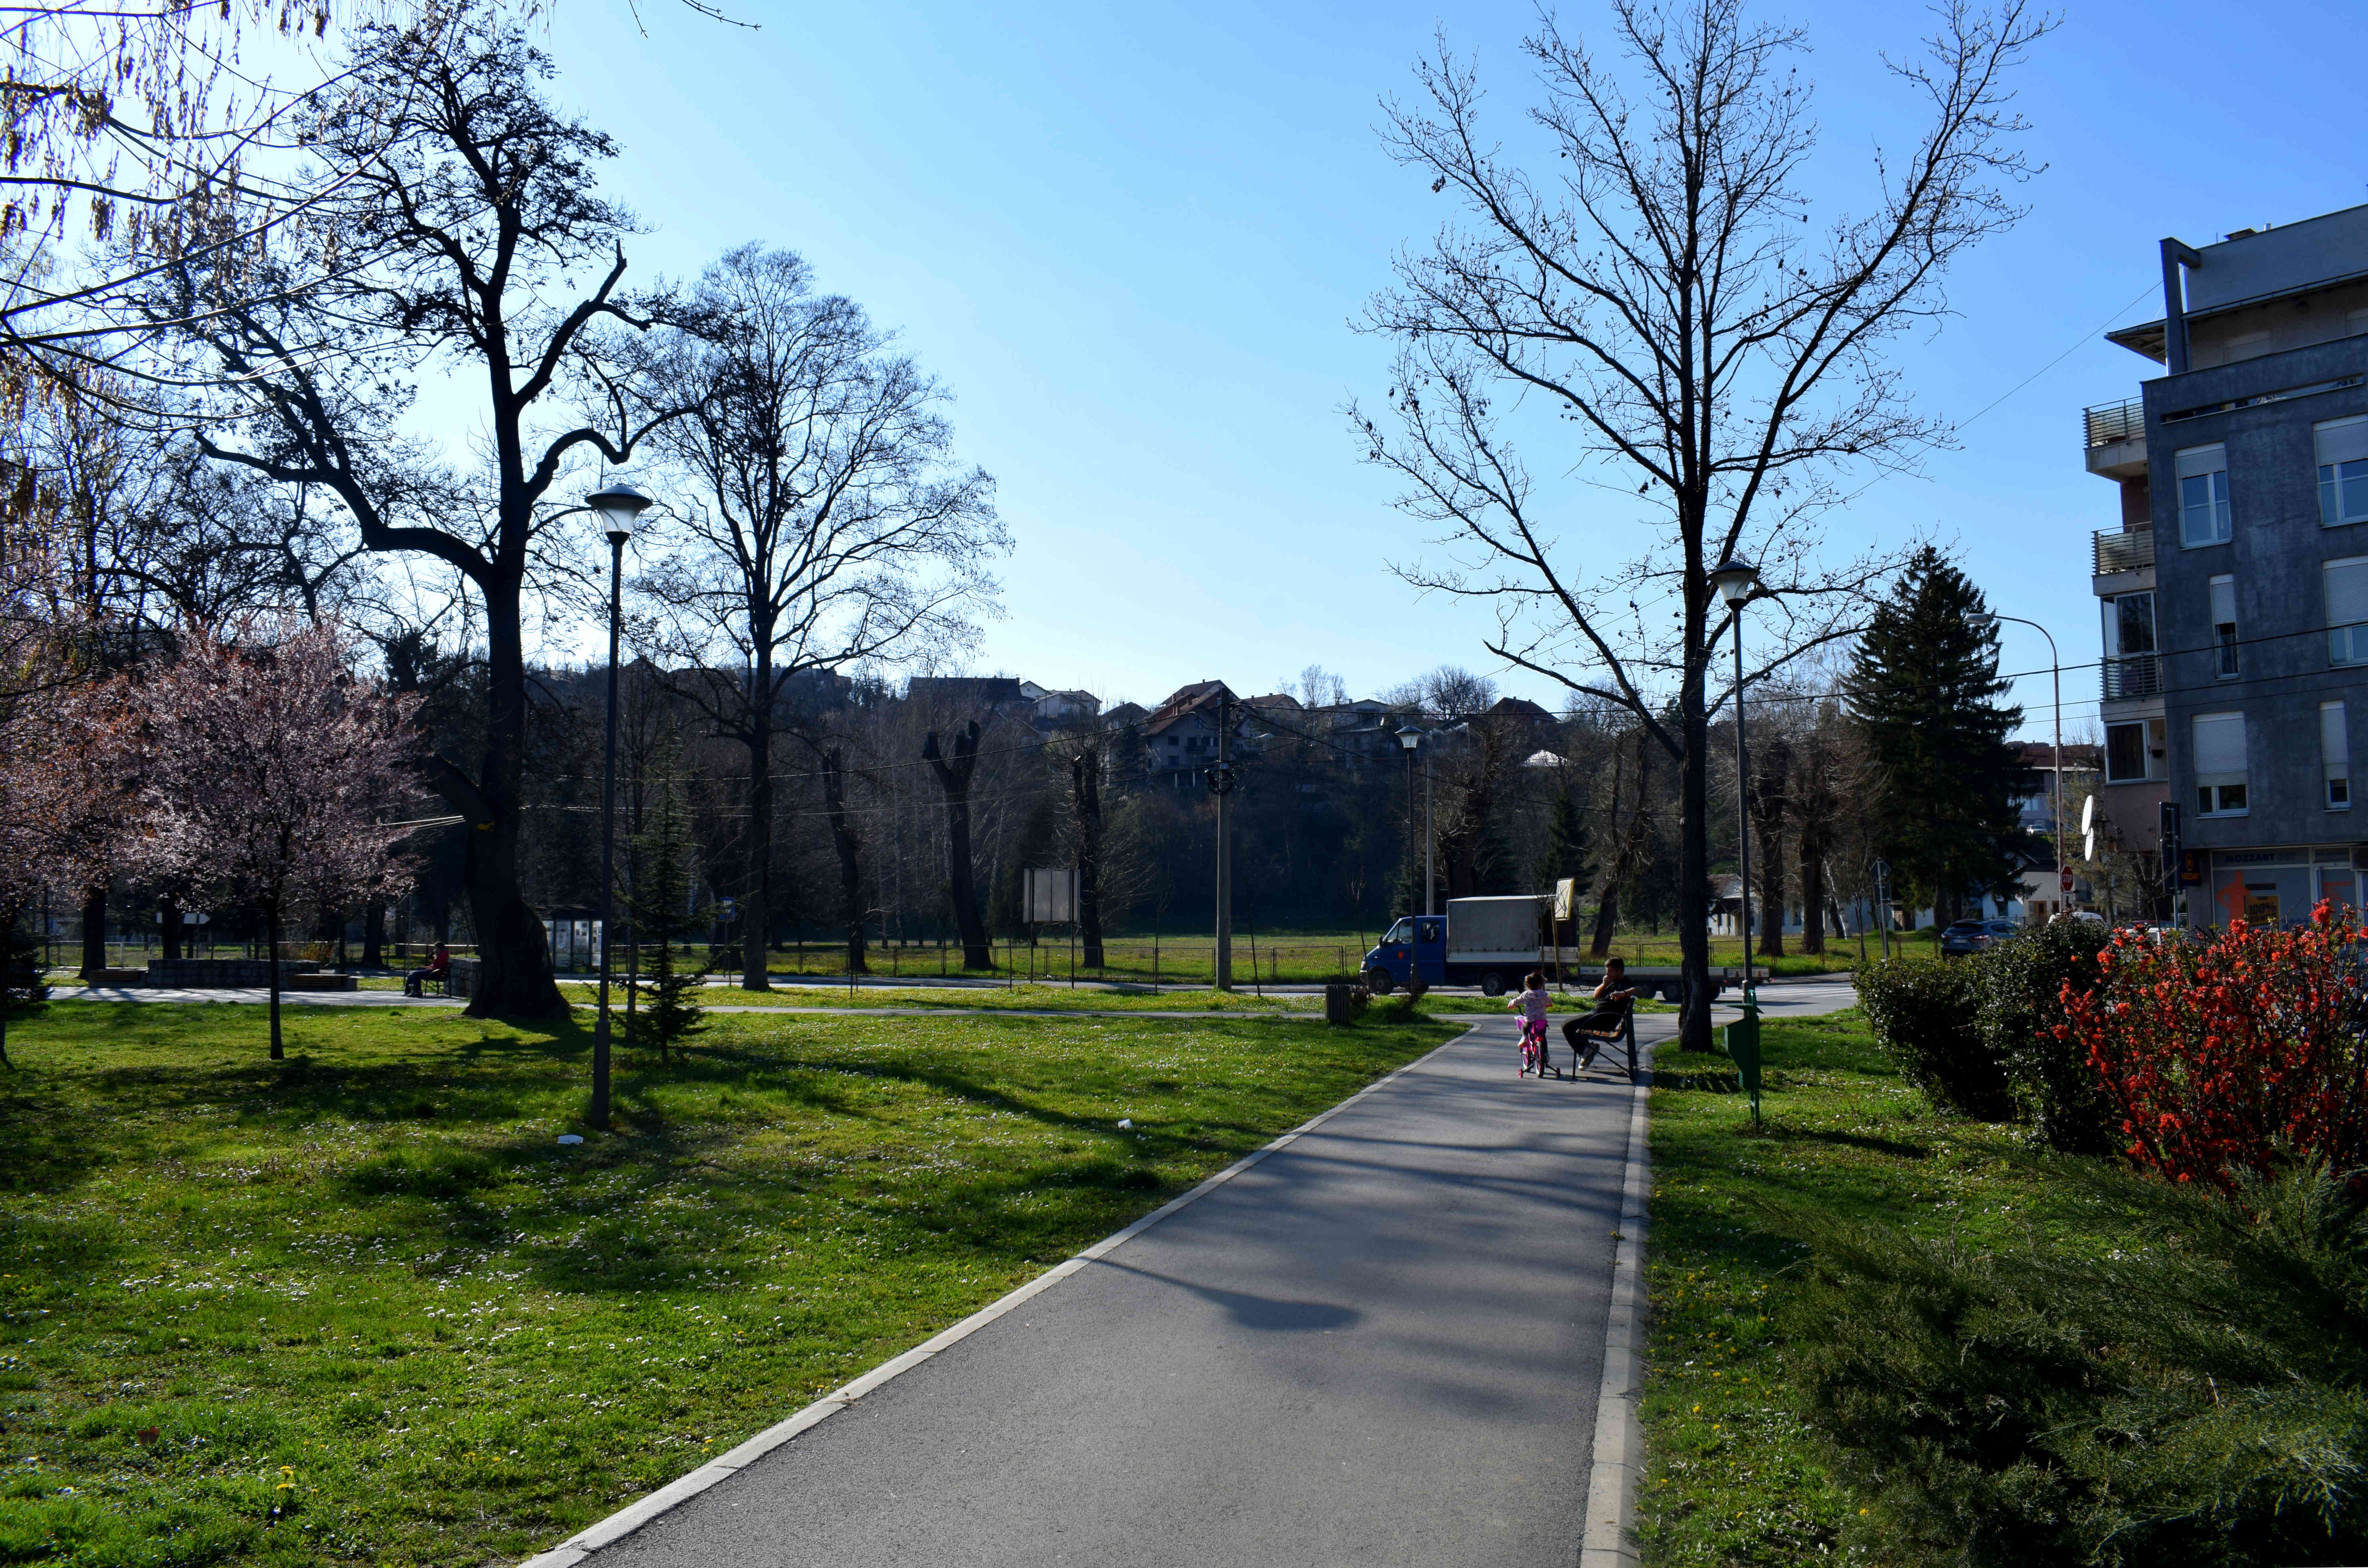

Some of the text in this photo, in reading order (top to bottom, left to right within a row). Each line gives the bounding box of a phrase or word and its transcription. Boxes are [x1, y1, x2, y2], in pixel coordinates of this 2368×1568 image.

[2225, 853, 2274, 862] MOZZART
[2063, 874, 2072, 883] STOP
[2250, 903, 2276, 914] 100%
